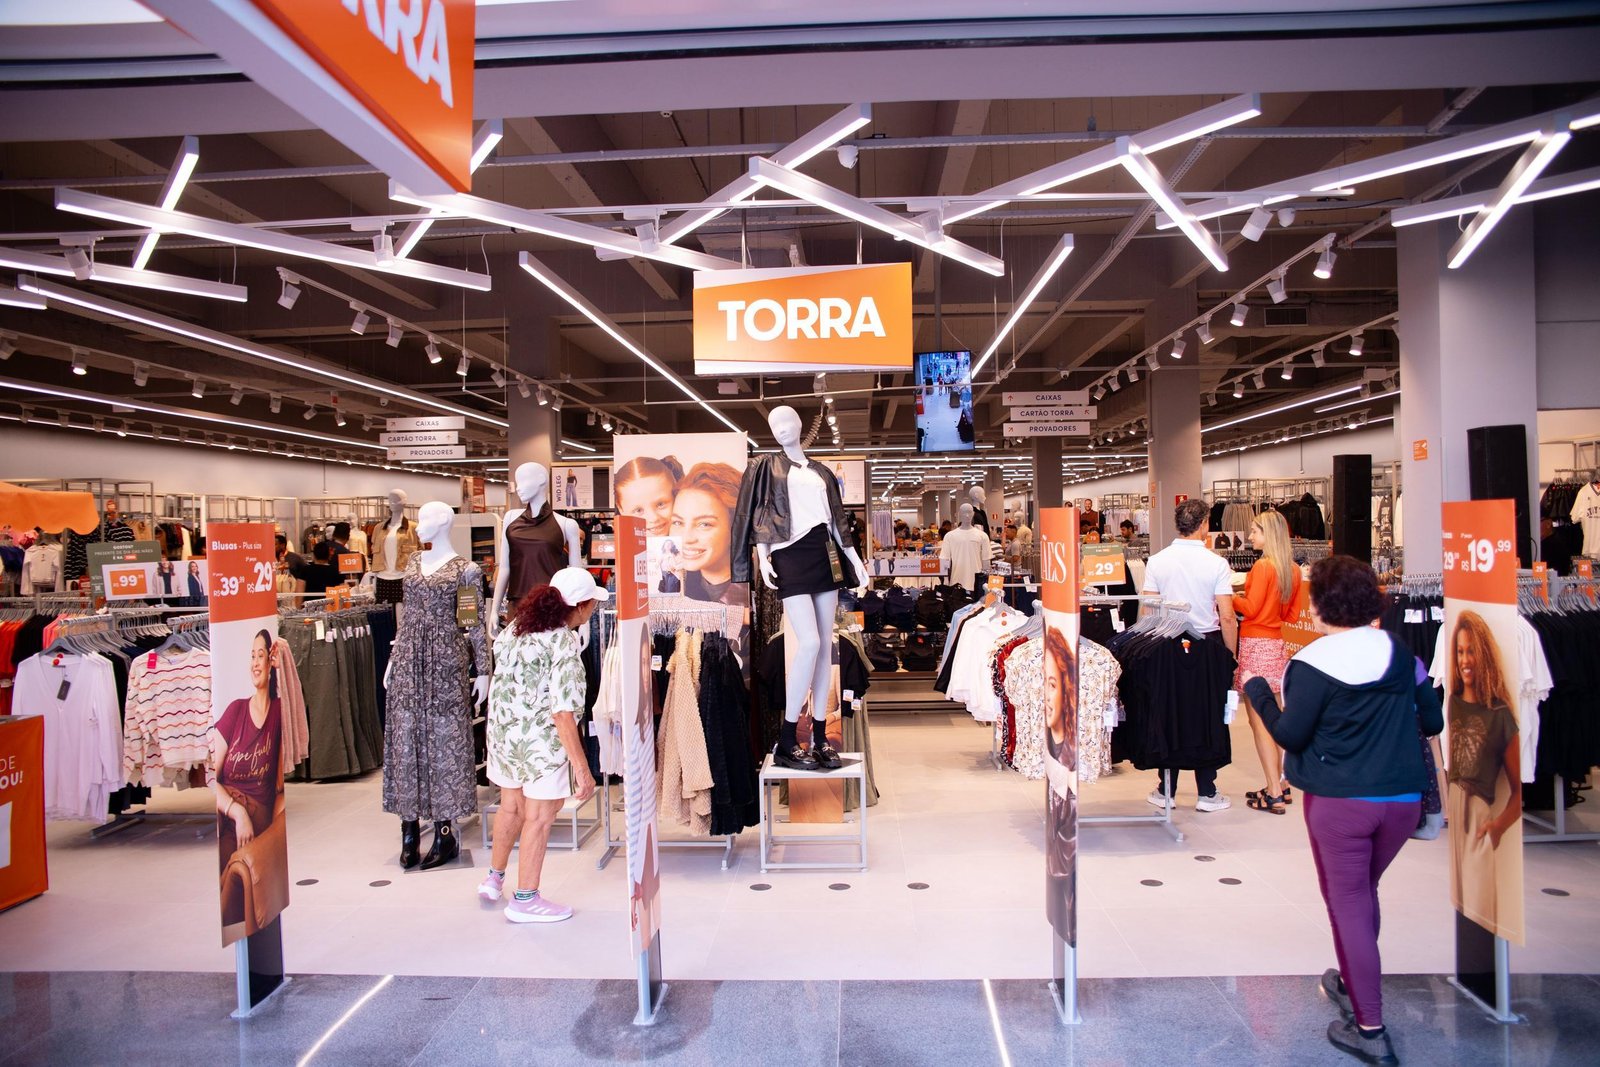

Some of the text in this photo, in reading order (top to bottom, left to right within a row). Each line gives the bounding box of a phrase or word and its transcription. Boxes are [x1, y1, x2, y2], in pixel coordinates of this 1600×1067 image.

[718, 296, 887, 342] TORRA
[1020, 408, 1074, 417] CARTÃO TORRA
[211, 540, 238, 551] Blusas
[1467, 538, 1495, 573] 19
[253, 561, 273, 593] 29
[1095, 562, 1114, 576] 29
[119, 574, 139, 588] 99
[220, 576, 240, 597] 39
